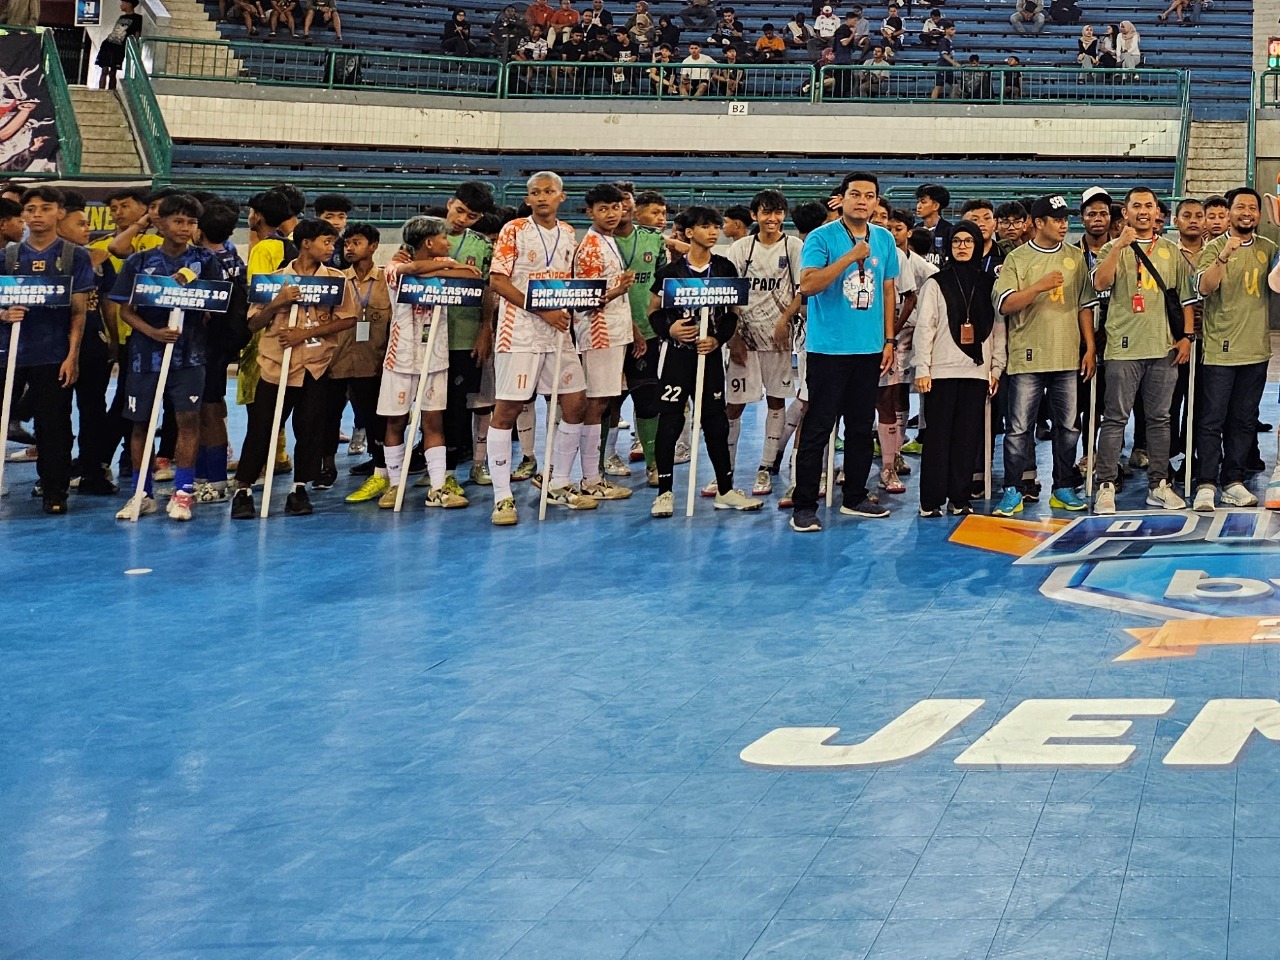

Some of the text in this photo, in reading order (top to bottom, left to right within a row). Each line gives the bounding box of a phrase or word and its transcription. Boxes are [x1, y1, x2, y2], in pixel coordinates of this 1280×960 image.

[732, 104, 745, 113] B2
[4, 285, 55, 295] NEGERI
[135, 283, 229, 301] SMP NEGERI 10
[255, 283, 282, 293] SMP
[330, 285, 339, 295] 2
[401, 283, 424, 294] SMP
[425, 285, 440, 295] AL
[531, 288, 603, 298] SMP NEGERI 4
[676, 286, 738, 297] MTS DARUL
[155, 295, 206, 308] JEMBER
[418, 294, 463, 305] JEMBER
[531, 297, 600, 308] BANYUWANGI
[674, 295, 739, 307] ISTIQOMAH
[517, 374, 528, 389] 11
[731, 378, 746, 392] 91
[661, 385, 683, 402] 22
